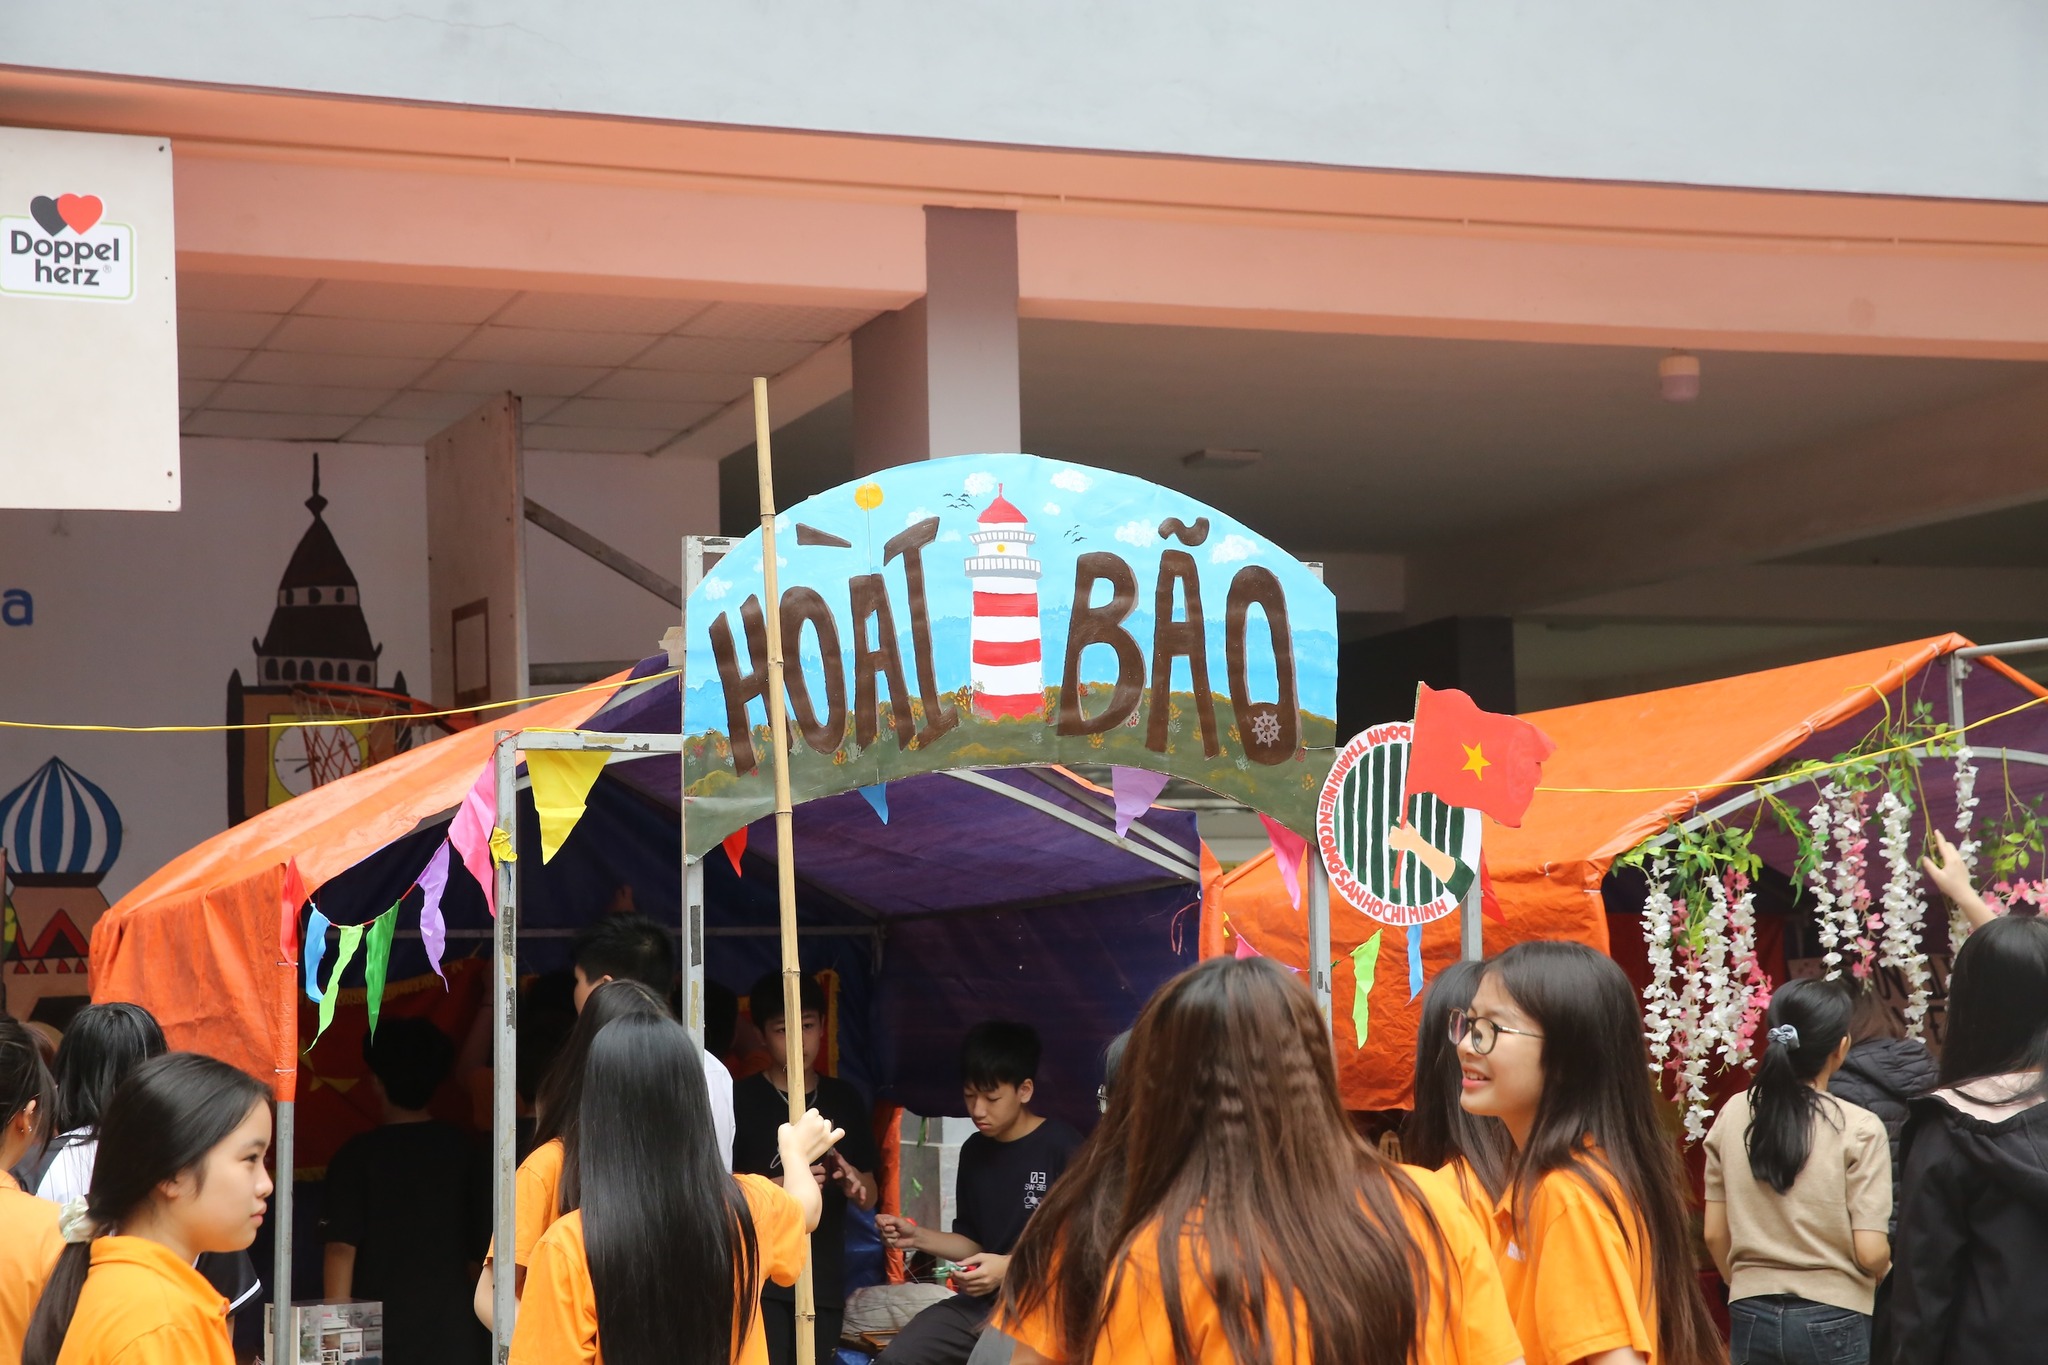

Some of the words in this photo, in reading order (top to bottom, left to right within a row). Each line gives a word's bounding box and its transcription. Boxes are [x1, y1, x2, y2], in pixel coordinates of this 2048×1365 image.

[11, 230, 120, 265] Doppel
[35, 259, 100, 286] herz
[1056, 517, 1303, 766] BÃO
[1327, 739, 1369, 788] THANH
[1318, 785, 1339, 825] NIEN
[1318, 825, 1345, 874] CONG
[1334, 870, 1366, 906] SAN
[1361, 893, 1384, 917] HO
[1382, 903, 1406, 924] CHI
[1408, 898, 1448, 924] MINH
[1030, 1171, 1046, 1184] 03
